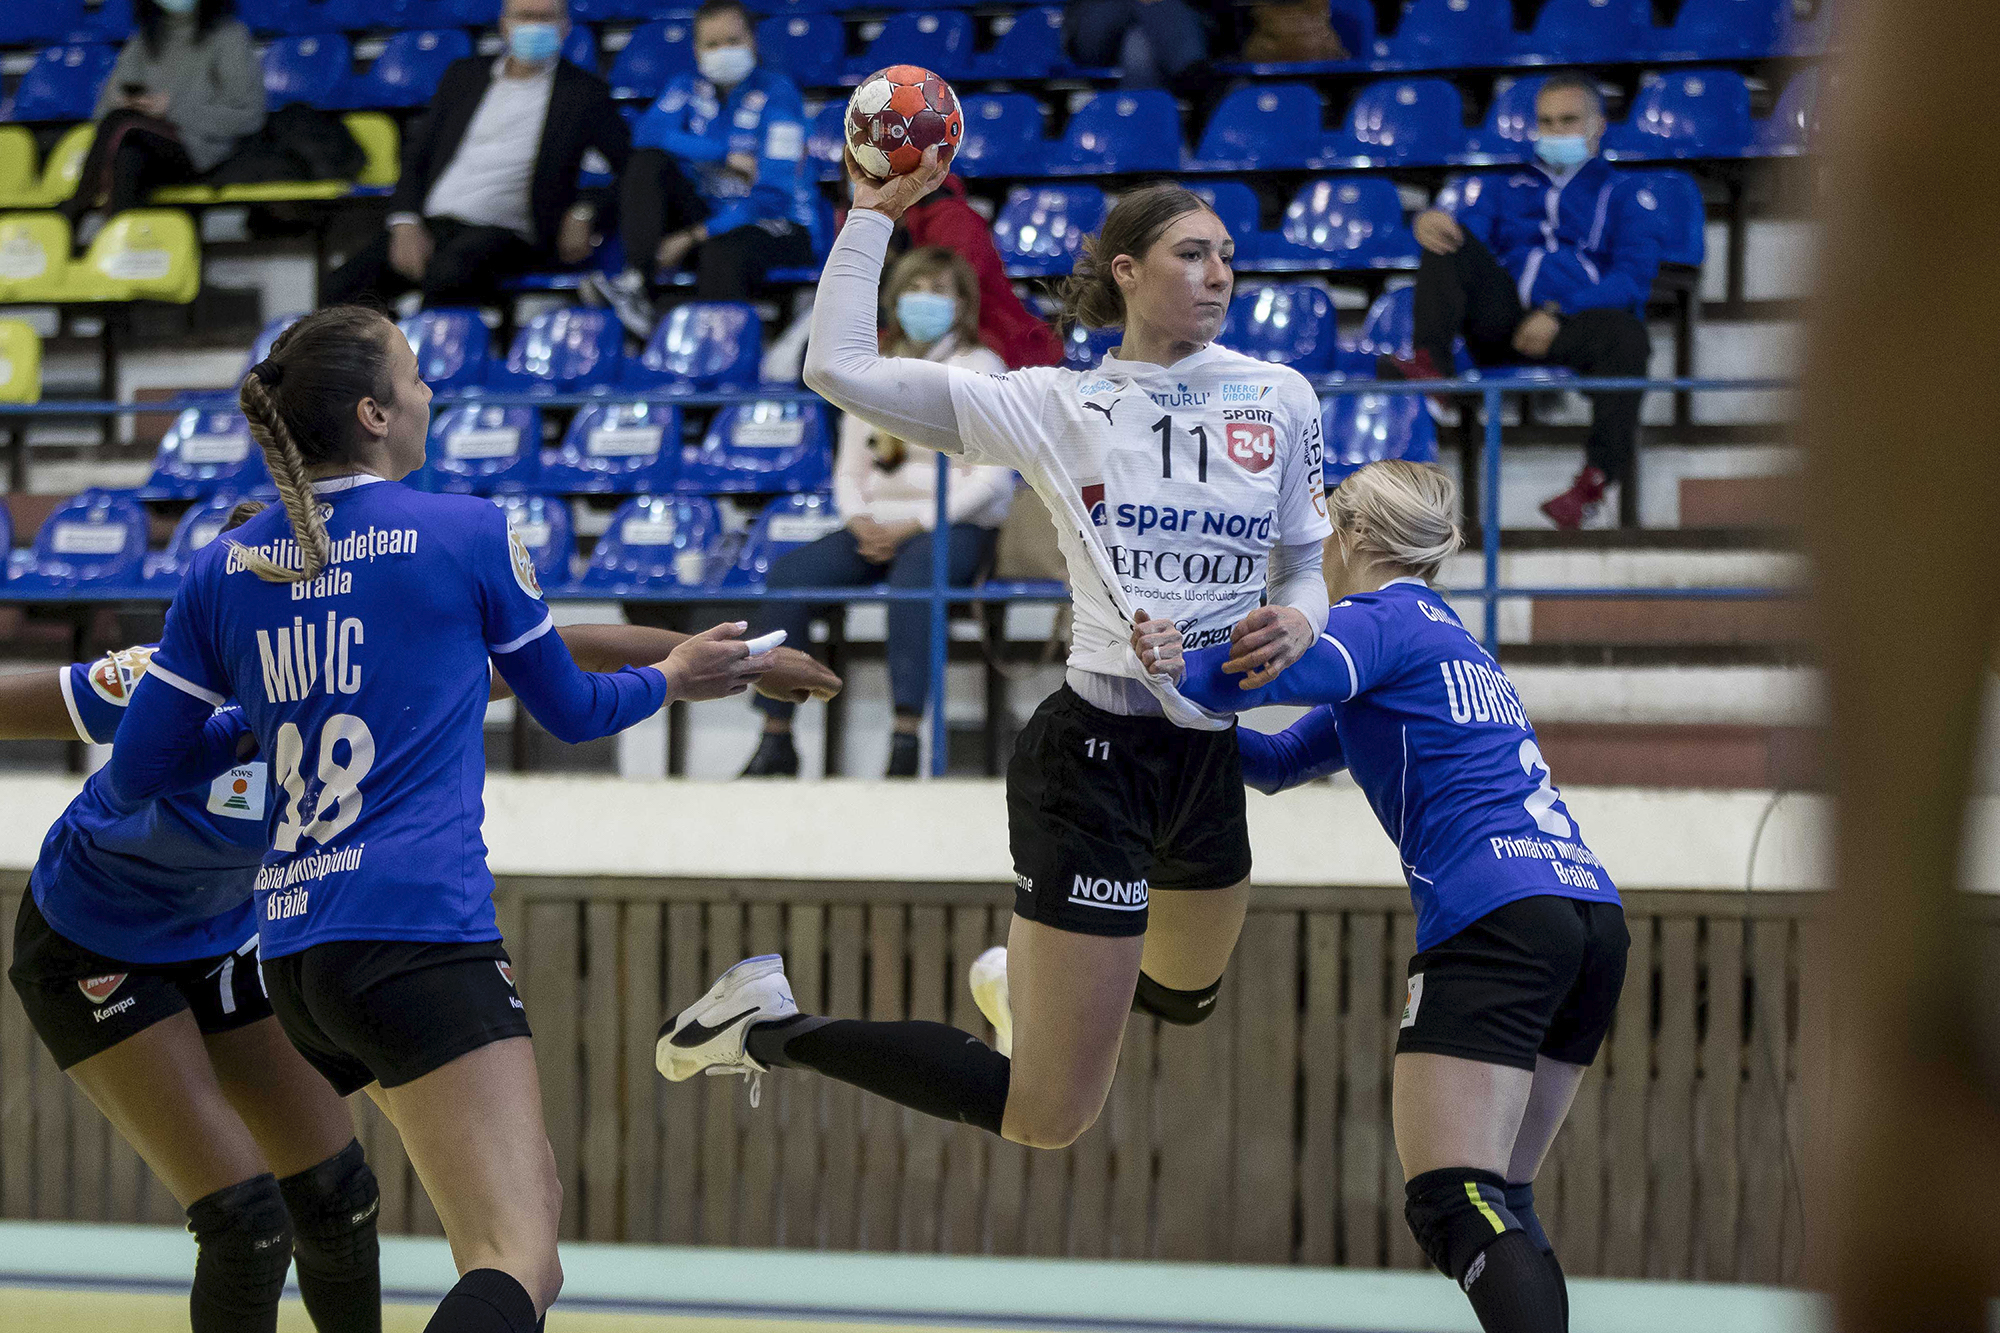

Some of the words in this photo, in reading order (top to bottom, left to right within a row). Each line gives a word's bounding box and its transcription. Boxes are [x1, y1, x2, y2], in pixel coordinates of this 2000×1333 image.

[1150, 392, 1211, 407] ATURLI'
[1222, 393, 1258, 402] VIBORG
[1223, 384, 1259, 393] ENERGI
[1223, 409, 1274, 424] SPORT
[1151, 415, 1208, 483] 11
[1232, 430, 1273, 461] 24
[1202, 513, 1272, 540] Nord
[330, 526, 418, 563] udețean
[1107, 545, 1254, 585] EFCOLD
[1135, 586, 1182, 600] Products
[1084, 738, 1111, 760] 11
[231, 769, 253, 778] KWS
[273, 713, 375, 852] 18
[1490, 836, 1556, 860] Primăria
[1551, 860, 1599, 890] Brăila
[267, 887, 309, 920] Brăila
[93, 997, 136, 1023] Kempa
